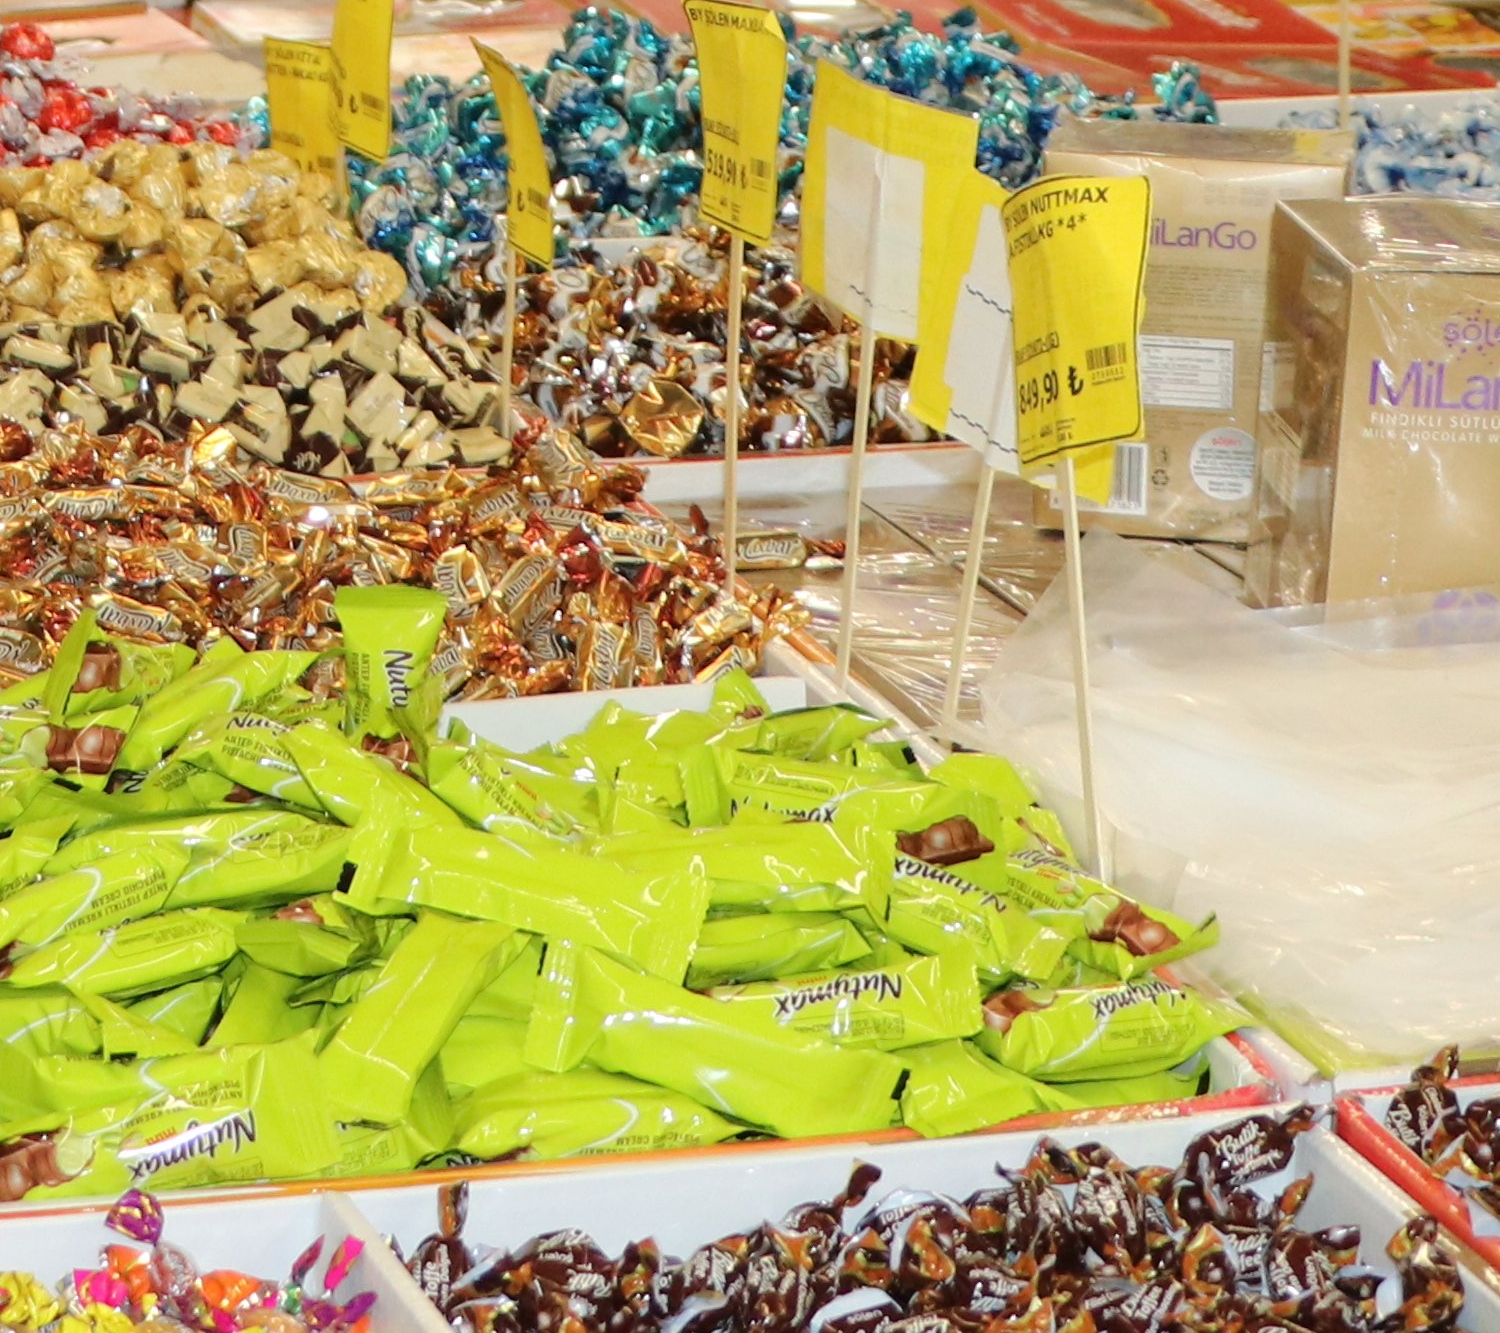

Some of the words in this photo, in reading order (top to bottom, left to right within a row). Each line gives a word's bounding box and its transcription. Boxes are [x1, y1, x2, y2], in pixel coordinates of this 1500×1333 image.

[1030, 186, 1108, 215] NUTTMAX
[1149, 221, 1258, 252] iLanGo
[1370, 412, 1441, 428] FINDIKLI
[773, 972, 902, 1019] Nutymax
[128, 1108, 257, 1183] Nutymax
